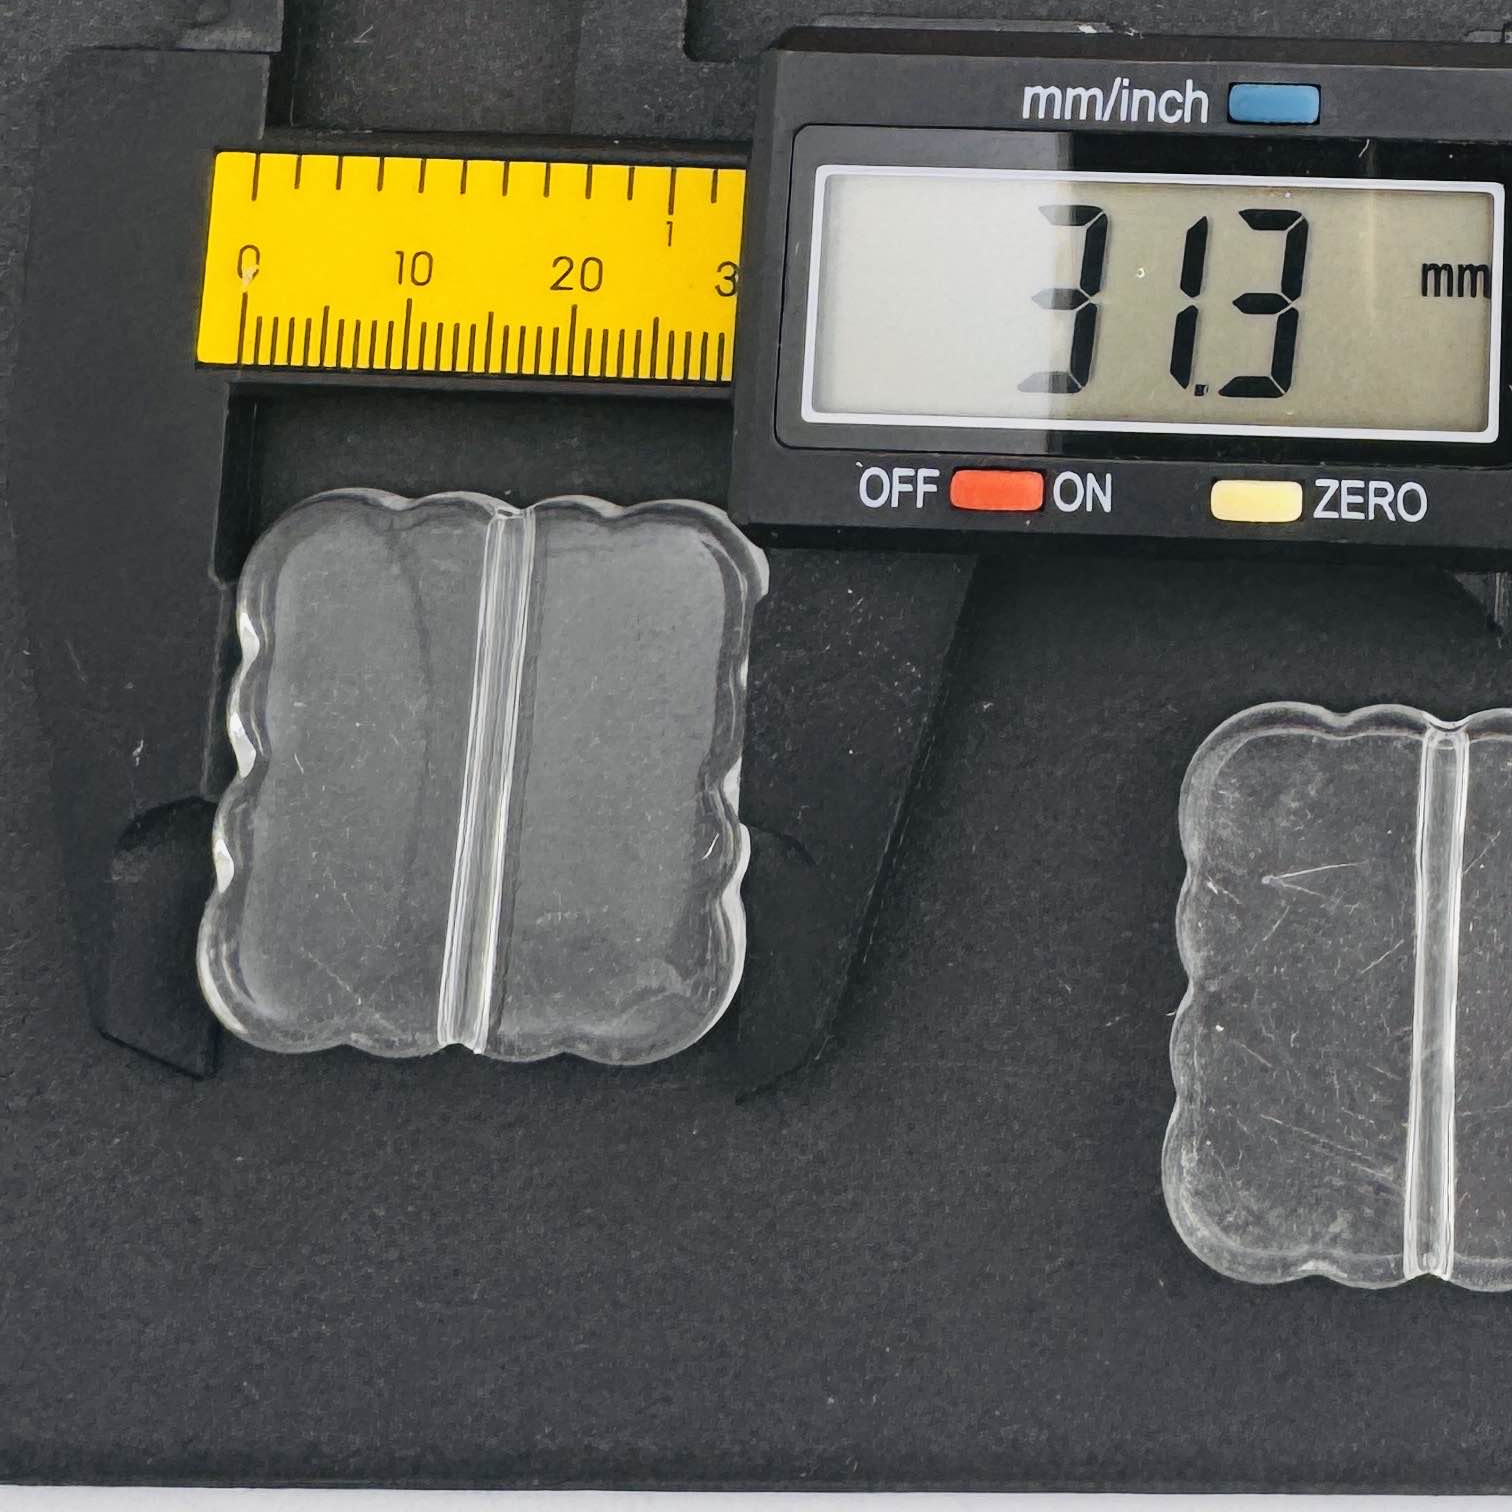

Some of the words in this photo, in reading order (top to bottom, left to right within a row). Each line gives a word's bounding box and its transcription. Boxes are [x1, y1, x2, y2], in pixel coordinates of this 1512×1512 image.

[1022, 76, 1209, 124] mm/inch
[666, 220, 674, 248] 1
[236, 244, 261, 283] 0
[395, 250, 434, 287] 10
[549, 255, 603, 293] 20
[714, 260, 738, 298] 3
[1421, 262, 1491, 300] mm
[859, 467, 940, 509] OFF
[1053, 470, 1112, 513] ON
[1313, 478, 1428, 523] ZERO
